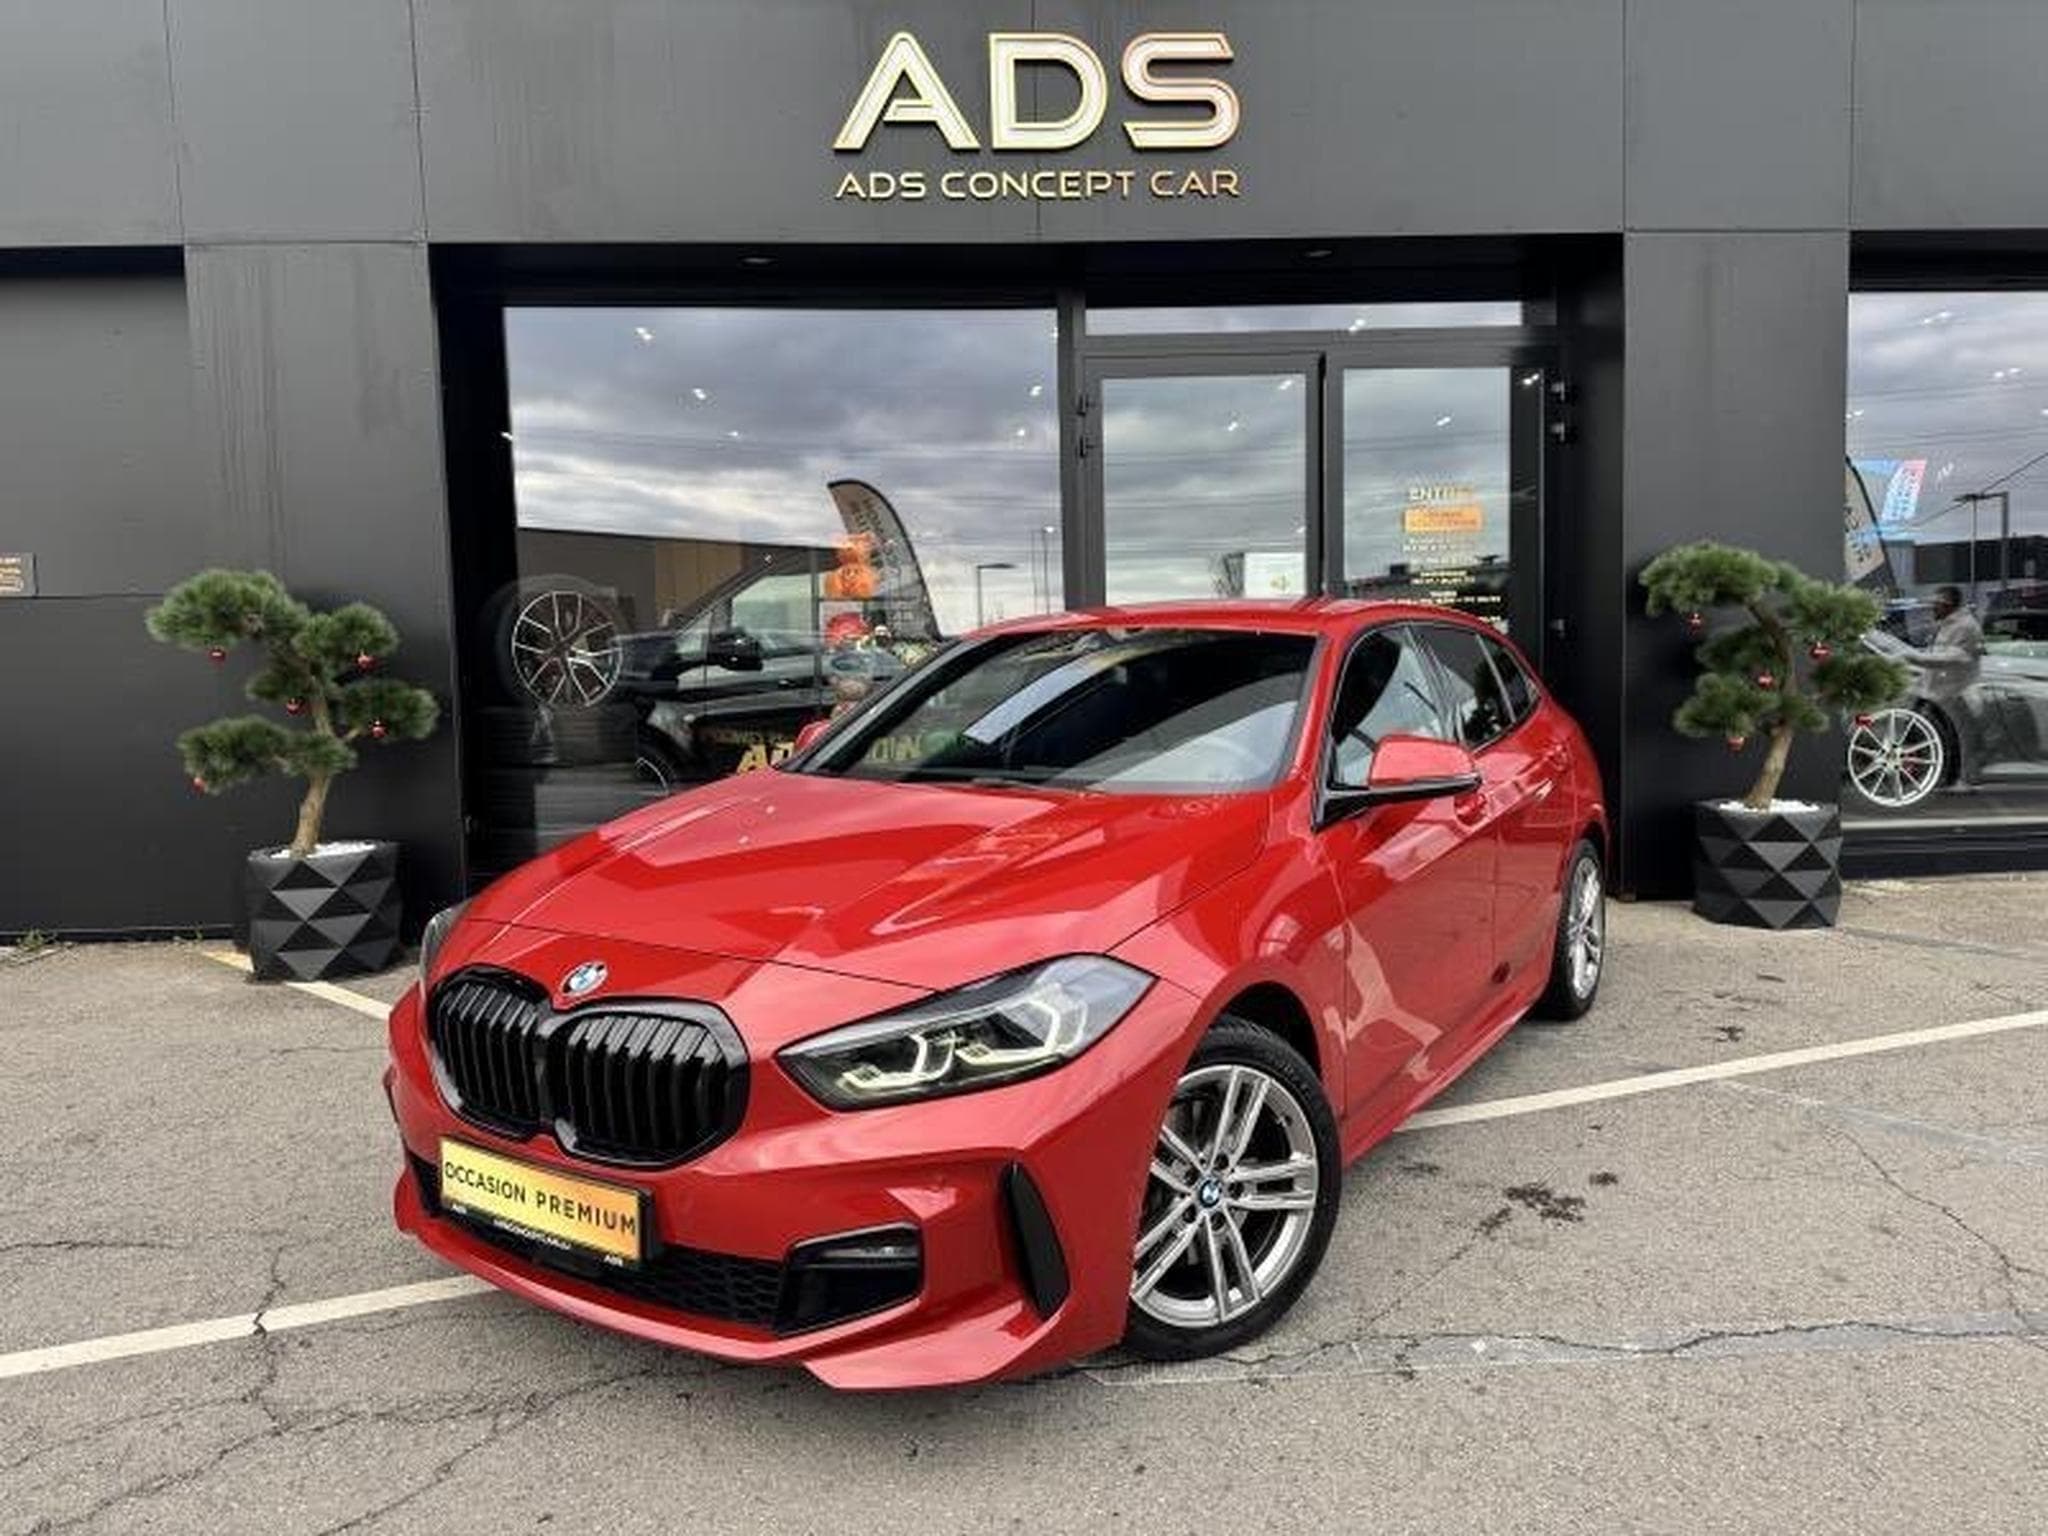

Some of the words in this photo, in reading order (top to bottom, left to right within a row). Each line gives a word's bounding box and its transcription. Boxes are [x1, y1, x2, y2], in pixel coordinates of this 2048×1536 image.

[833, 32, 1241, 149] ADS
[836, 172, 926, 198] ADS
[940, 171, 1135, 197] CONCEPT
[1150, 170, 1240, 196] CAR
[444, 1161, 526, 1204] OCCASION
[536, 1191, 635, 1235] PREMIUM
